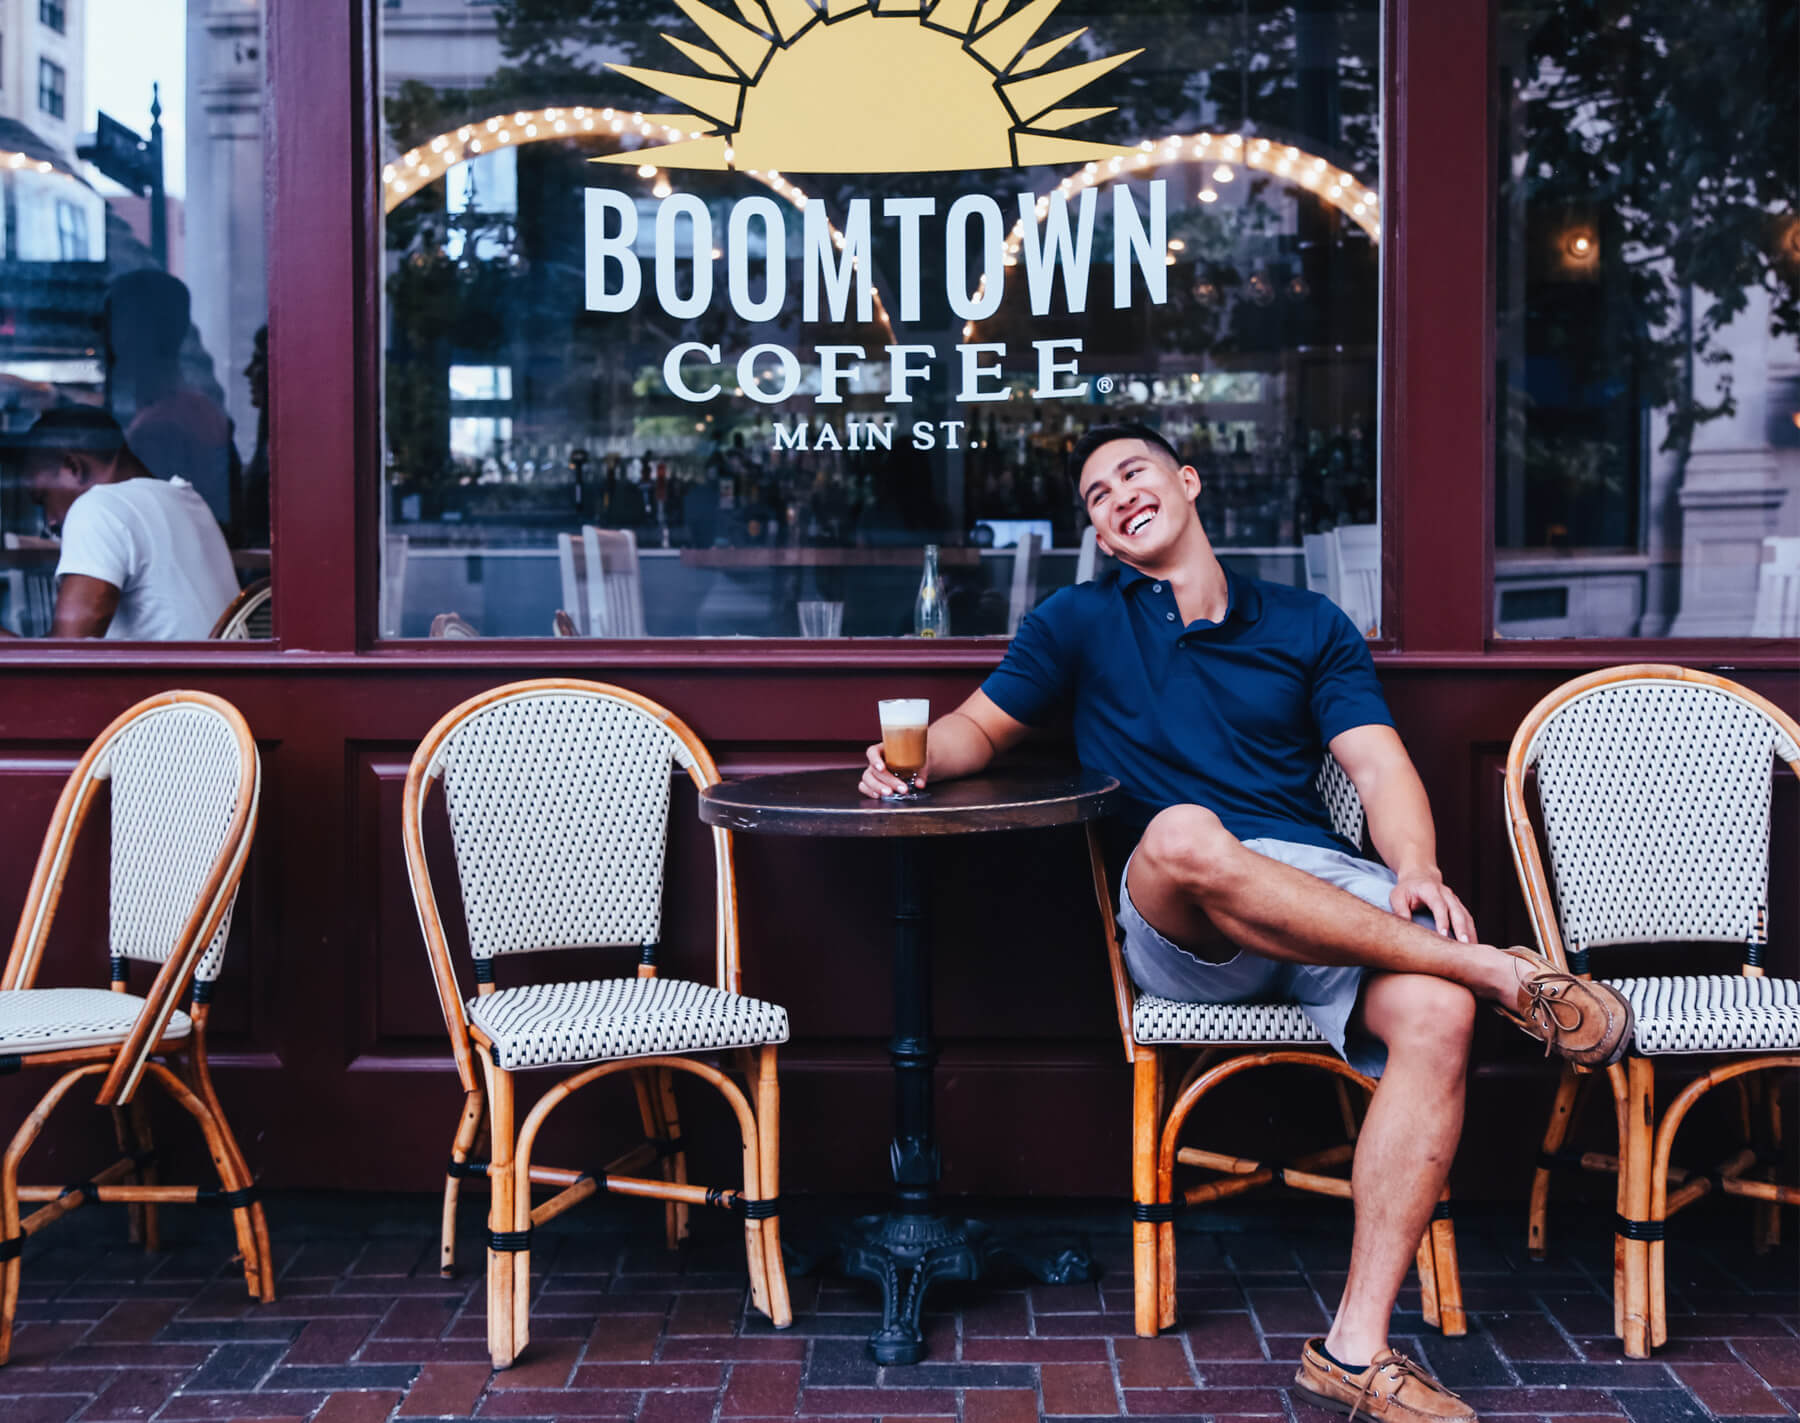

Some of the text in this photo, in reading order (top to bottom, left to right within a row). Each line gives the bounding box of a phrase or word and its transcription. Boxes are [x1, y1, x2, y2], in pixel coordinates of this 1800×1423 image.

[583, 178, 1169, 323] BOOMTOWN
[771, 420, 979, 451] MAIN ST.
